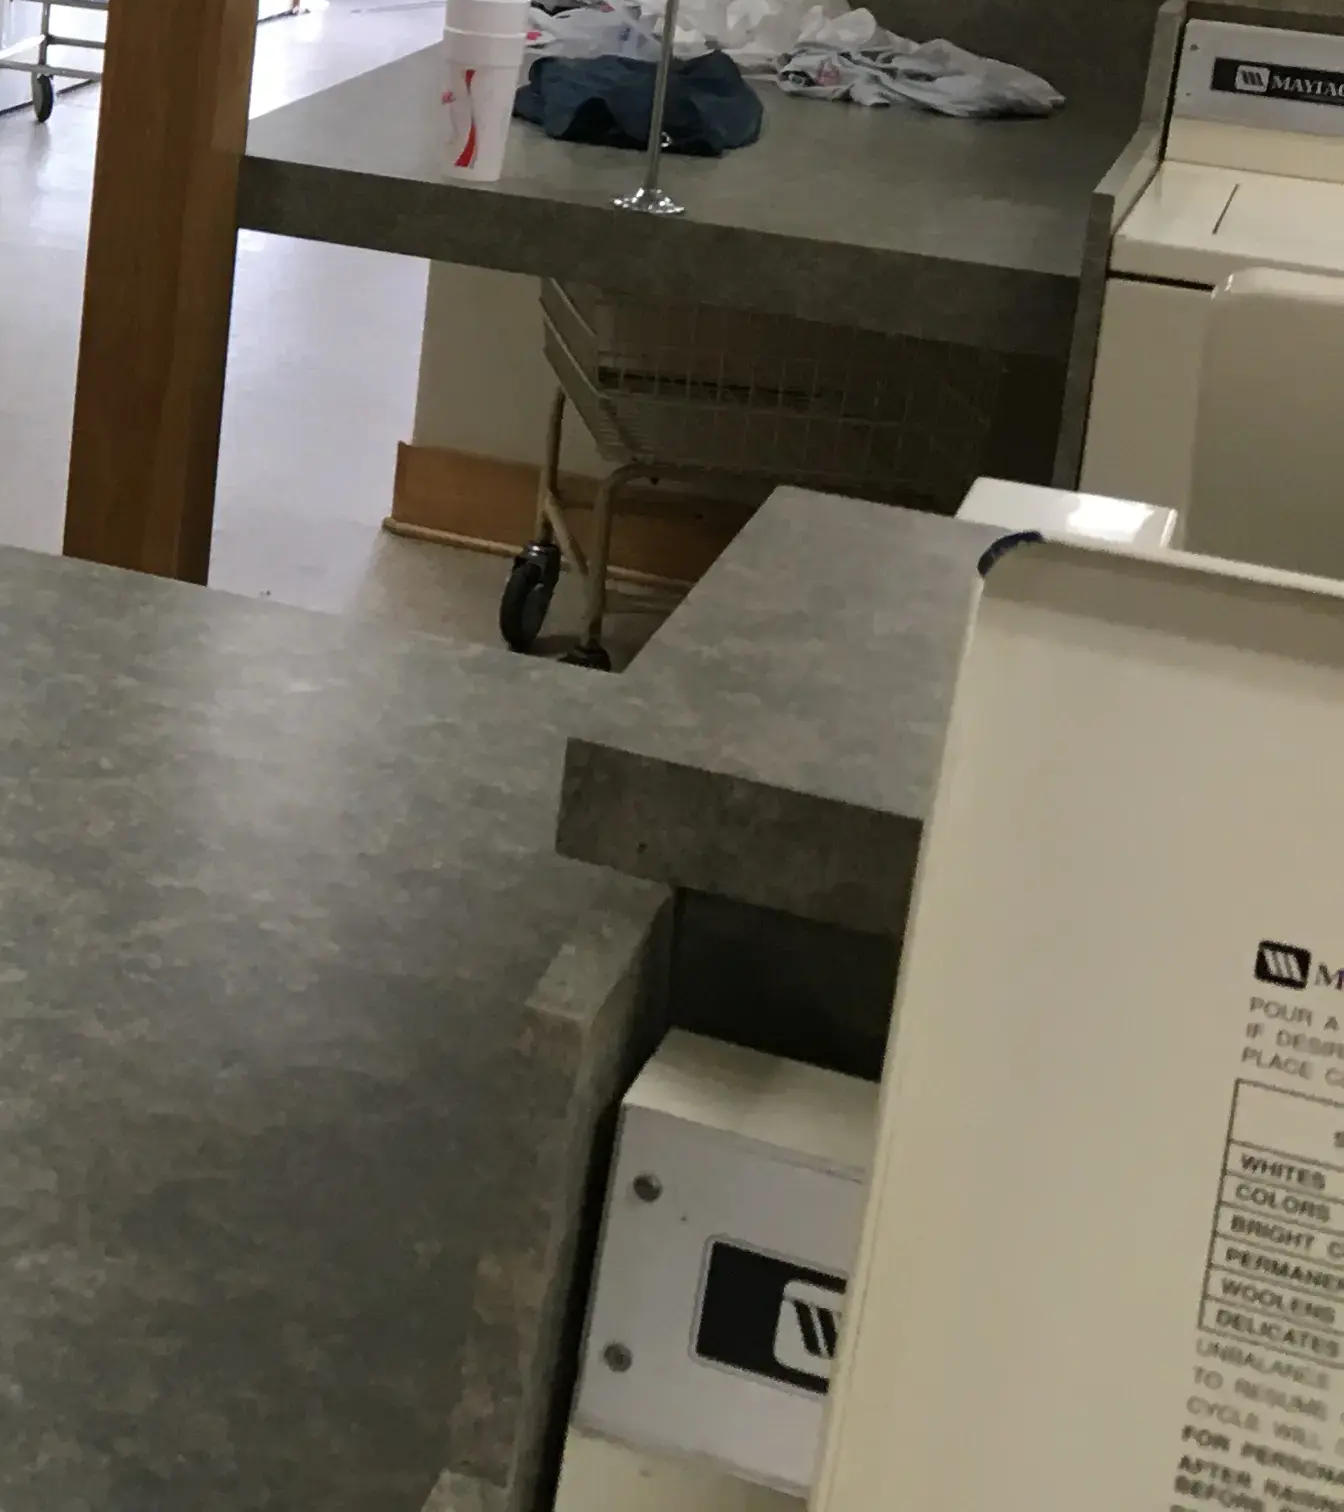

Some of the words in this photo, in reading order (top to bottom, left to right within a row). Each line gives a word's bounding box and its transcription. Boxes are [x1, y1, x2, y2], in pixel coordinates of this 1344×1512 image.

[1246, 1023, 1264, 1038] IF
[1250, 997, 1312, 1027] POUR
[1324, 1016, 1339, 1031] A
[1241, 1047, 1313, 1080] PLACE
[1241, 1154, 1326, 1190] WHITES
[1236, 1183, 1330, 1222] COLORS
[1230, 1214, 1315, 1250] BRIGHT
[1222, 1277, 1336, 1324] WOOLENS
[1216, 1308, 1339, 1358] DELICATES
[1193, 1366, 1224, 1390] TO
